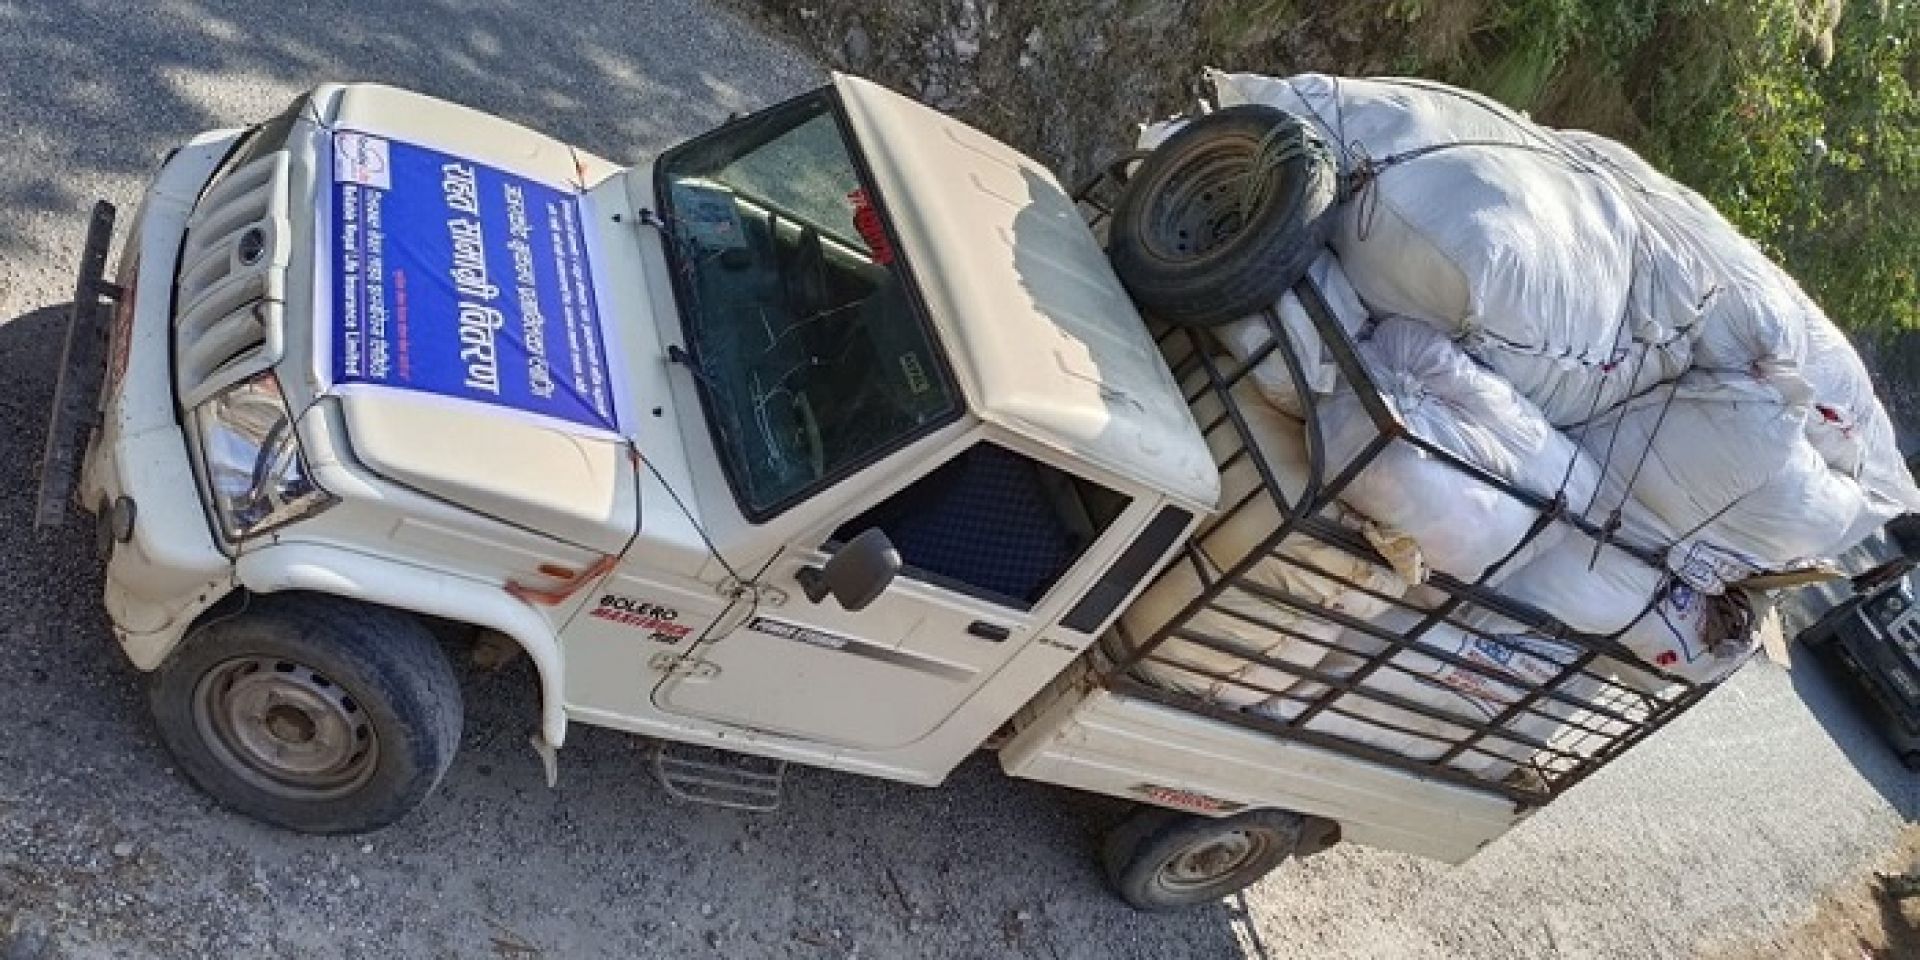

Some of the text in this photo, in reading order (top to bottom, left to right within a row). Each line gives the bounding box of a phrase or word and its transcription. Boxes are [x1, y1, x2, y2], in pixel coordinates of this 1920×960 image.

[441, 163, 480, 217] राहत
[340, 184, 361, 376] Reliable Nepal Life Insurance Limited
[457, 301, 505, 396] वितरण
[599, 594, 679, 621] BOLERO
